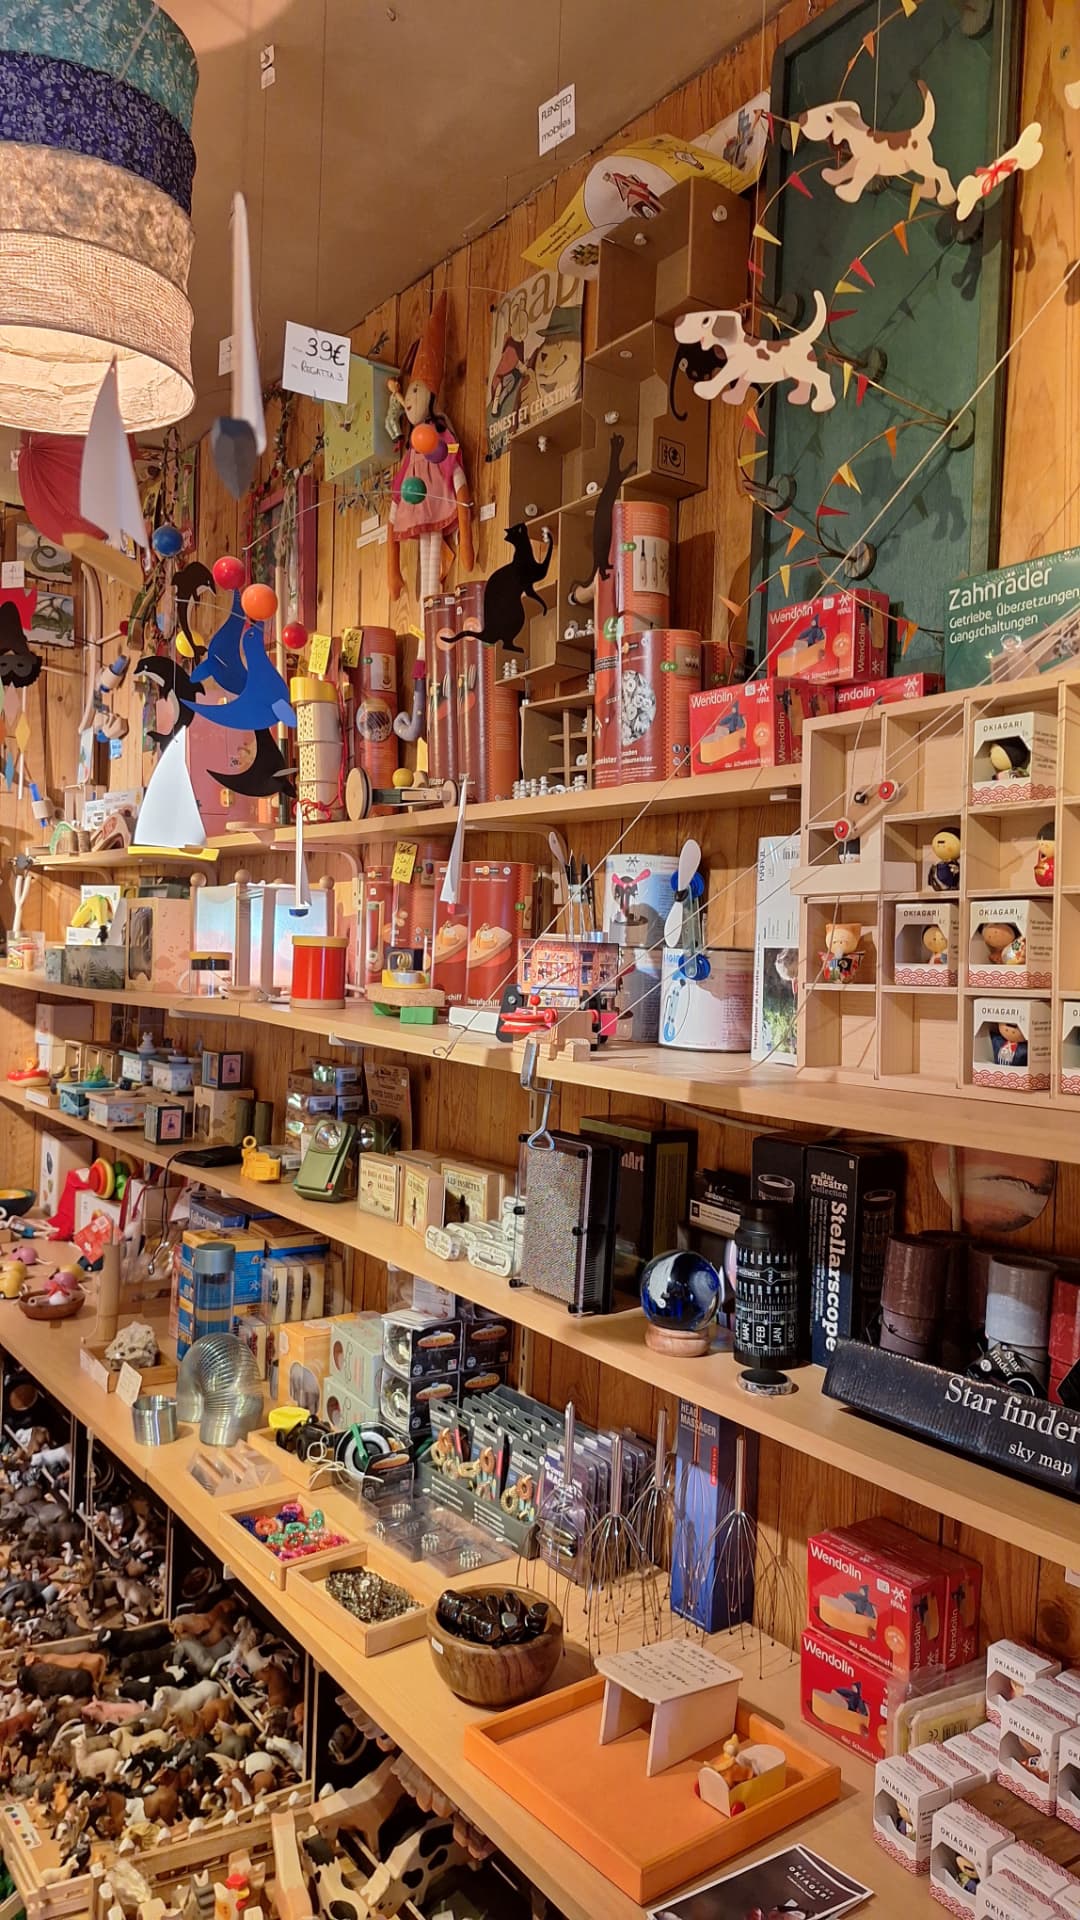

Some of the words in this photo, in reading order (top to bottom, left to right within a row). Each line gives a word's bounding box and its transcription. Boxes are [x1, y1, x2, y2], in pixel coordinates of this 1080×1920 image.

[541, 94, 572, 121] FLENSTED
[541, 117, 571, 142] mobiles
[305, 337, 347, 366] 39€
[518, 405, 530, 424] ET
[948, 567, 1052, 611] Zahnräder
[770, 605, 813, 625] Wendolin
[949, 609, 993, 630] Getriebe,
[949, 613, 1038, 645] Gangschaltungen
[857, 622, 867, 673] Wendolin
[691, 691, 733, 709] Wendolin
[838, 686, 876, 701] endolin
[777, 711, 786, 762] Wendolin
[983, 720, 1023, 732] OKIAGARI
[903, 909, 940, 917] OKIAGARI
[979, 908, 1018, 917] OKIAGARI
[981, 1007, 1019, 1016] OKIAGARI
[825, 1200, 847, 1352] Stellarscope
[742, 1323, 751, 1342] MAR
[756, 1325, 767, 1344] FEB
[773, 1327, 783, 1344] JAN
[788, 1325, 796, 1343] DEC
[1004, 1351, 1022, 1372] Star
[944, 1377, 998, 1416] Star
[1000, 1396, 1080, 1444] finder
[1008, 1441, 1036, 1463] sky
[1038, 1454, 1073, 1476] map
[810, 1543, 862, 1582] Wendolin
[913, 1621, 922, 1671] Wendolin
[949, 1608, 959, 1662] Wendolin
[803, 1636, 855, 1678] Wendolin
[994, 1657, 1027, 1681] OKIAGARI
[1008, 1717, 1044, 1743] OKIAGARI
[881, 1775, 912, 1804] OKIAGARI
[940, 1826, 978, 1857] OKIAGARI
[788, 1865, 831, 1900] OKIAGARI
